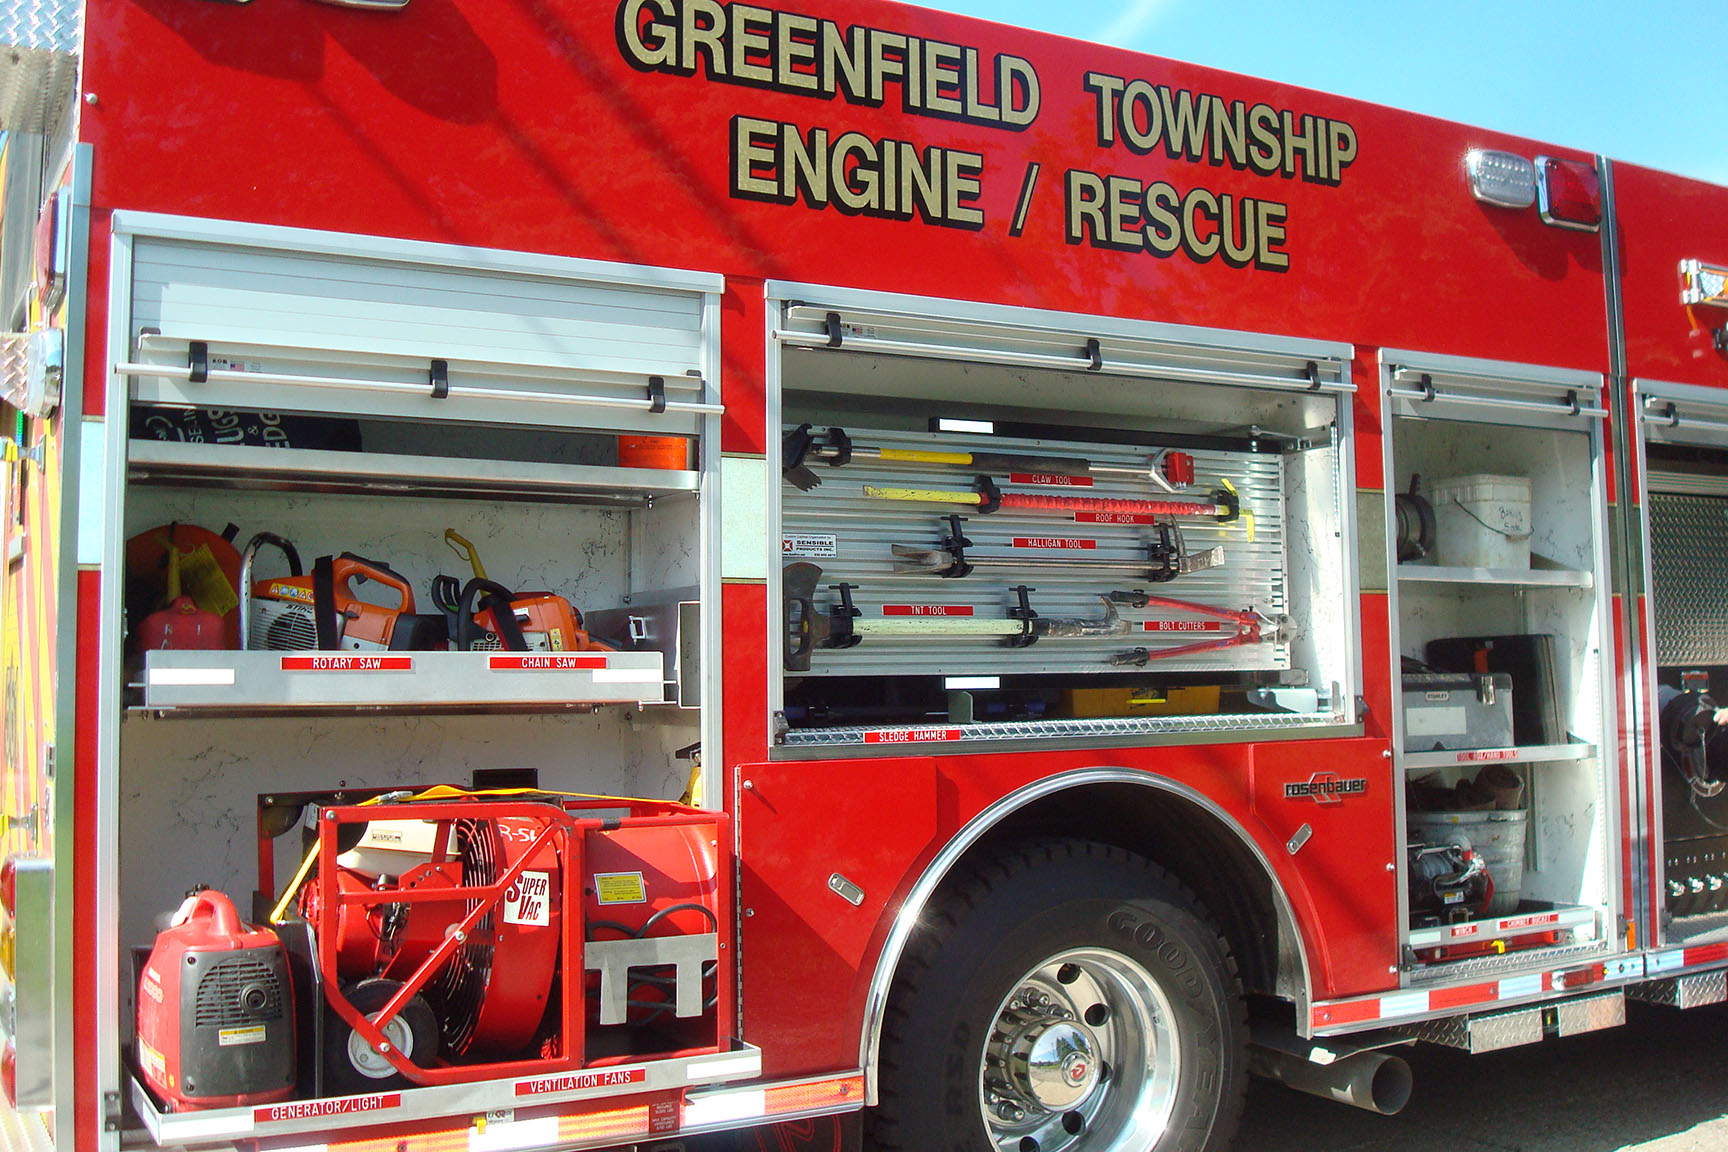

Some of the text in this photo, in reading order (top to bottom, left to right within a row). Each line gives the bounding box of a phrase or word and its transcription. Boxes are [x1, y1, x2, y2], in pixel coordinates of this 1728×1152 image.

[616, 0, 1358, 186] GREENFIELD TOWNSHIP
[730, 115, 1290, 273] ENGINE / RESCUE
[1032, 475, 1072, 485] CLAW TOOL
[1095, 513, 1135, 523] ROOF HOOK
[1027, 538, 1082, 548] HALLIGAN TOOL
[911, 606, 946, 615] TNT TOOL
[1159, 621, 1206, 630] BOLT CUTTERS
[312, 657, 382, 669] ROTARY SAW
[521, 657, 577, 668] CHAIN SAW
[879, 730, 947, 742] SLEDGE HAMMER
[1285, 776, 1366, 796] rosenbauer
[506, 873, 547, 903] SUPER
[518, 895, 541, 920] VAC
[530, 1071, 631, 1093] VENTILATION FANS
[271, 1097, 383, 1120] GENERATOR/LIGHT
